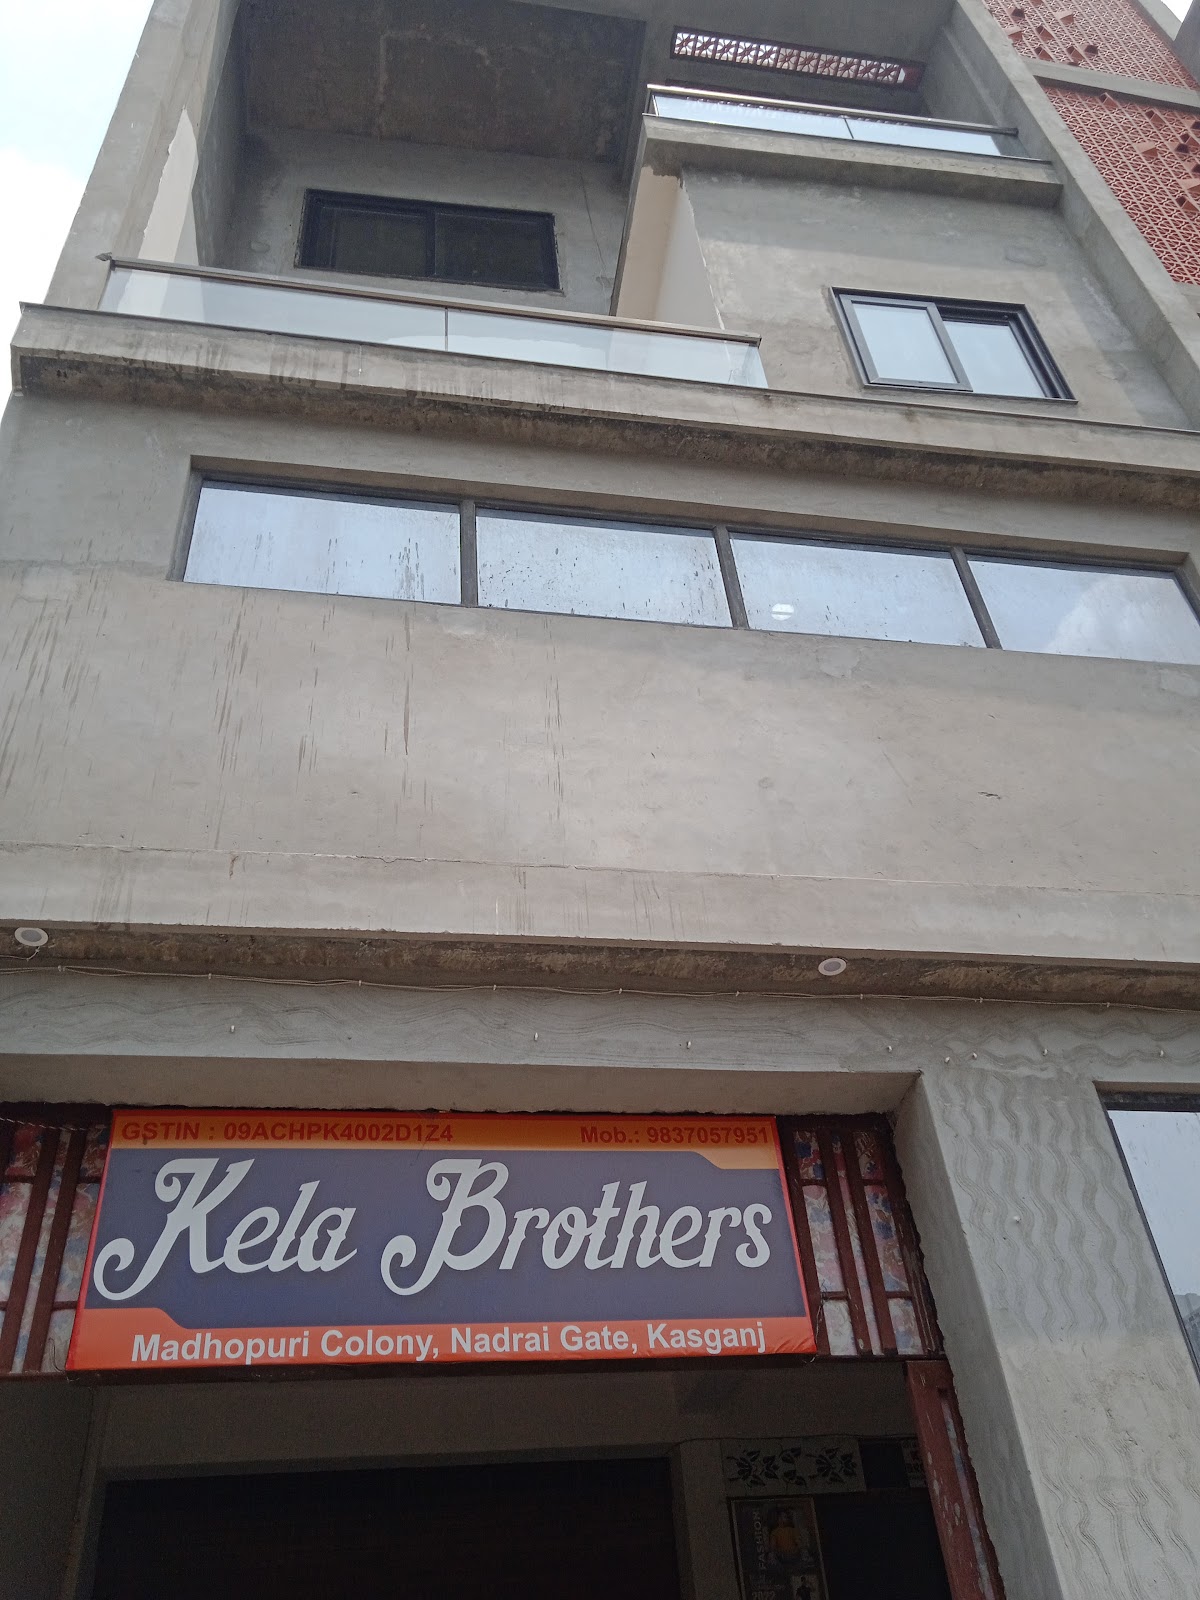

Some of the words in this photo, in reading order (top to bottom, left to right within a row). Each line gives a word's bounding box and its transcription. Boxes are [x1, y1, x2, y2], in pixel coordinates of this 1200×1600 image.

[121, 1122, 200, 1141] GSTIN
[223, 1122, 453, 1142] 09ACHPK4002D1Z4
[580, 1126, 640, 1144] Mob.:
[646, 1127, 769, 1144] 9837057951
[93, 1158, 357, 1300] Kela
[380, 1158, 772, 1296] Brothers
[131, 1330, 309, 1365] Madhopuri
[320, 1329, 439, 1360] Colony,
[450, 1326, 549, 1353] Nadrai
[560, 1325, 638, 1353] Gate,
[647, 1322, 766, 1354] Kasganj
[752, 1511, 766, 1570] FASHION
